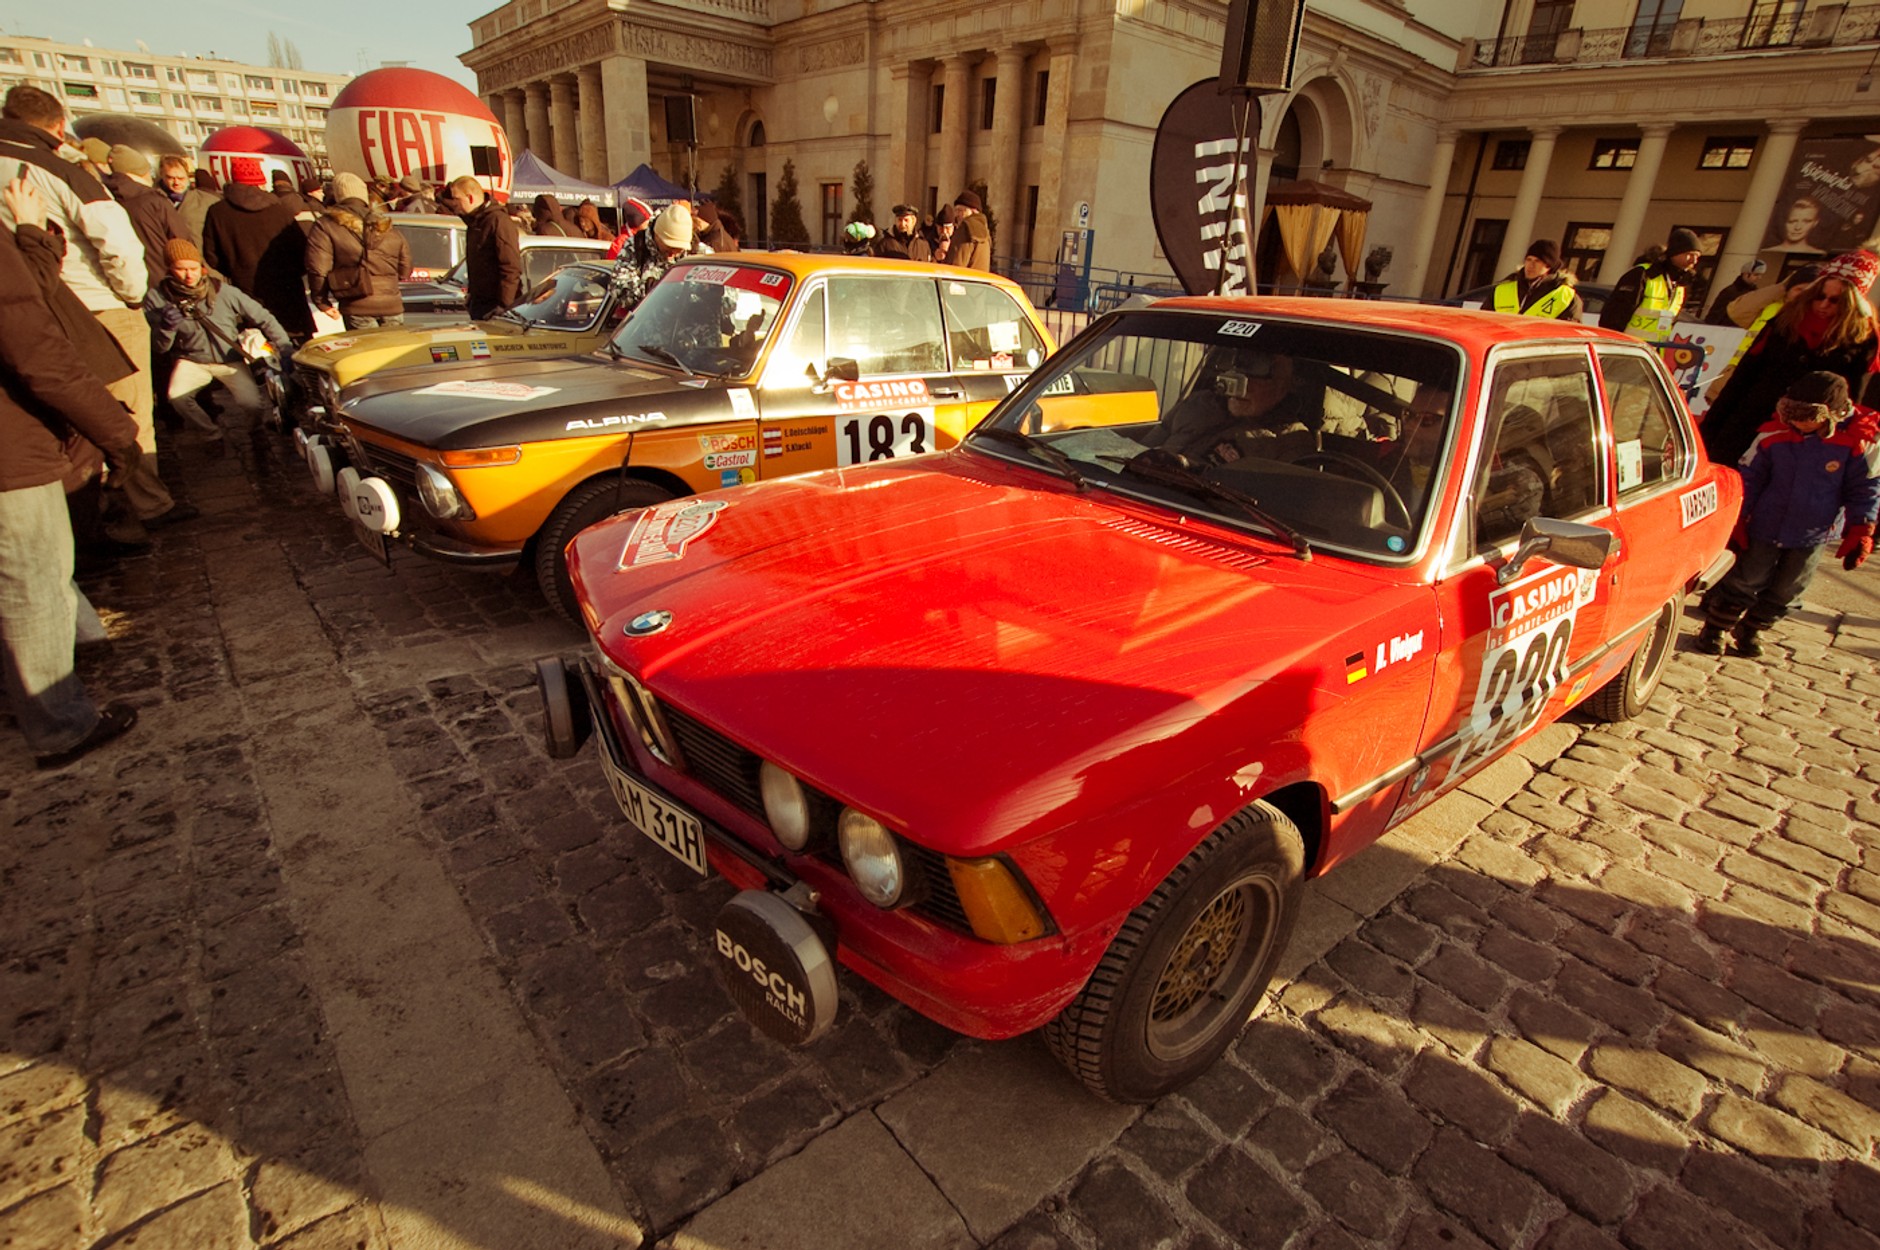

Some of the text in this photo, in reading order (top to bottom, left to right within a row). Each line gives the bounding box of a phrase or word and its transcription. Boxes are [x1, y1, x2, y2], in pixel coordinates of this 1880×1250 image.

[358, 110, 446, 181] FIAT
[1195, 137, 1250, 296] MINI
[762, 274, 780, 285] 183
[1223, 322, 1256, 336] 220
[1630, 315, 1658, 330] 37
[837, 381, 925, 400] CASINO
[841, 396, 928, 410] DE MONTE-CARLO
[565, 411, 668, 431] ALPINA
[711, 436, 755, 451] BOSCH
[843, 412, 926, 466] 183
[715, 452, 749, 467] Castrol
[1496, 572, 1577, 630] CASINO
[1490, 599, 1574, 649] DE MONTE-CARLO
[1455, 618, 1571, 774] 220
[716, 928, 805, 1017] BOSCH
[765, 991, 807, 1030] RALLYE
